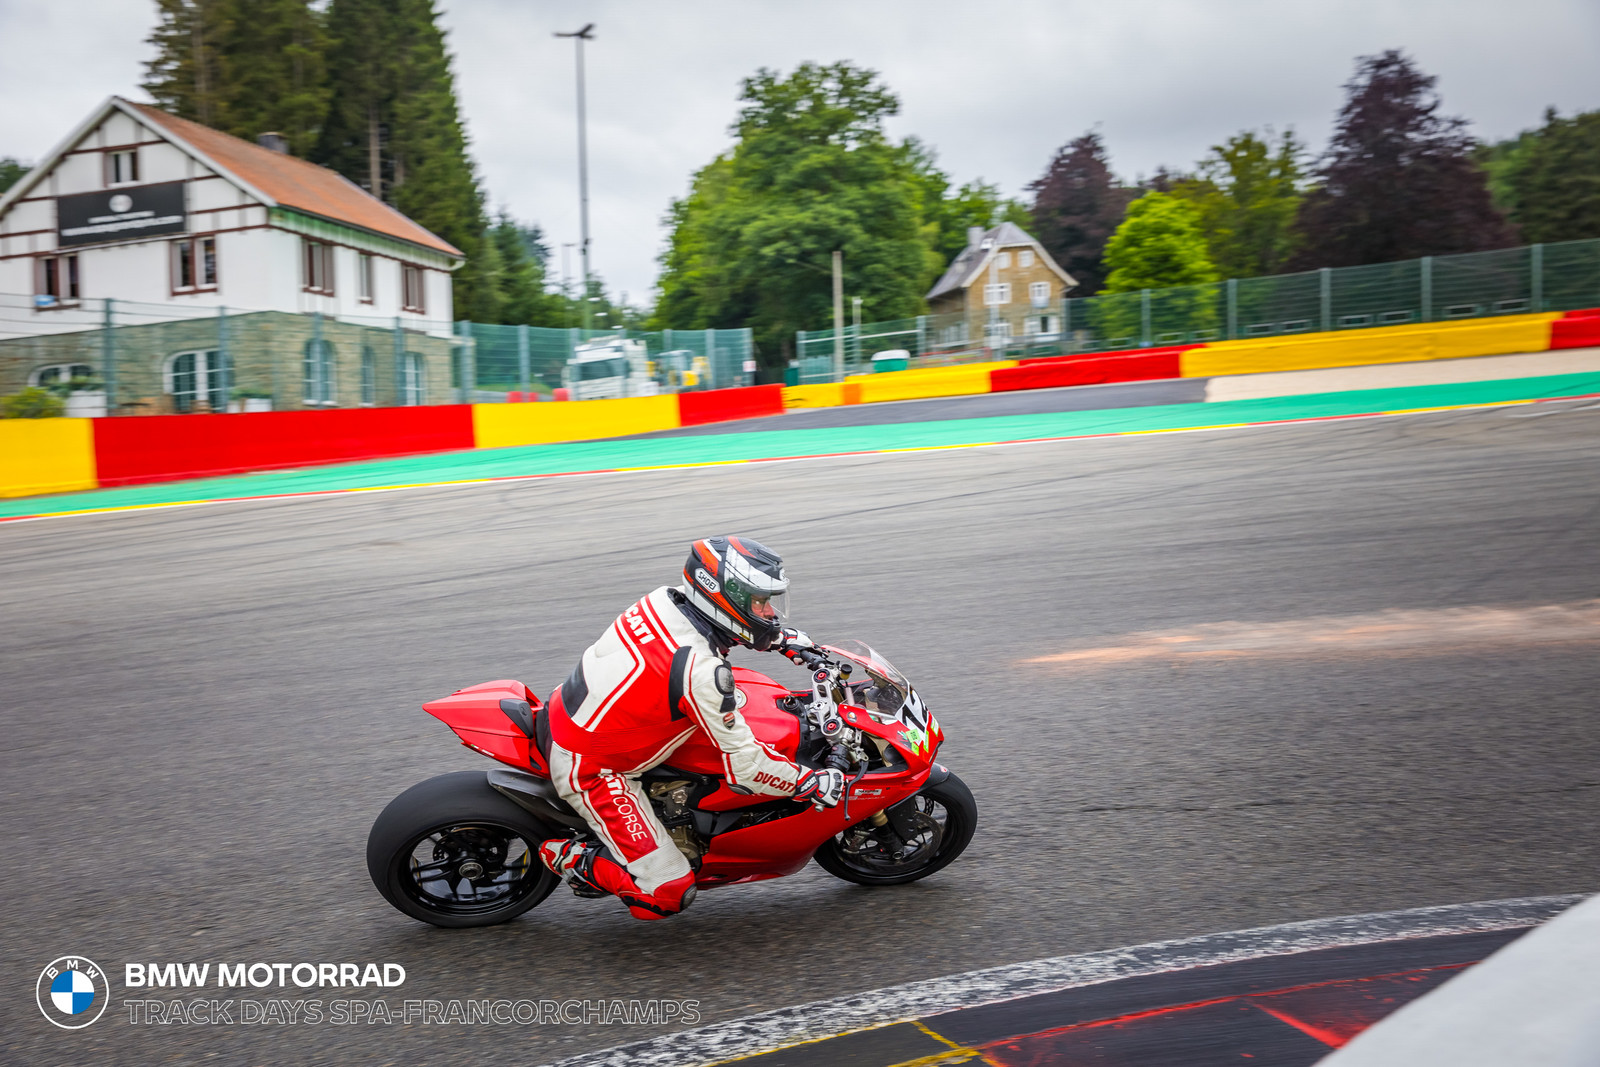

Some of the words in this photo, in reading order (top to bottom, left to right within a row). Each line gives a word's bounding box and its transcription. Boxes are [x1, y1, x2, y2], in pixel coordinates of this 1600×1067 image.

[698, 571, 716, 590] SHOEI
[623, 604, 656, 645] CATI
[613, 796, 648, 842] CORSE
